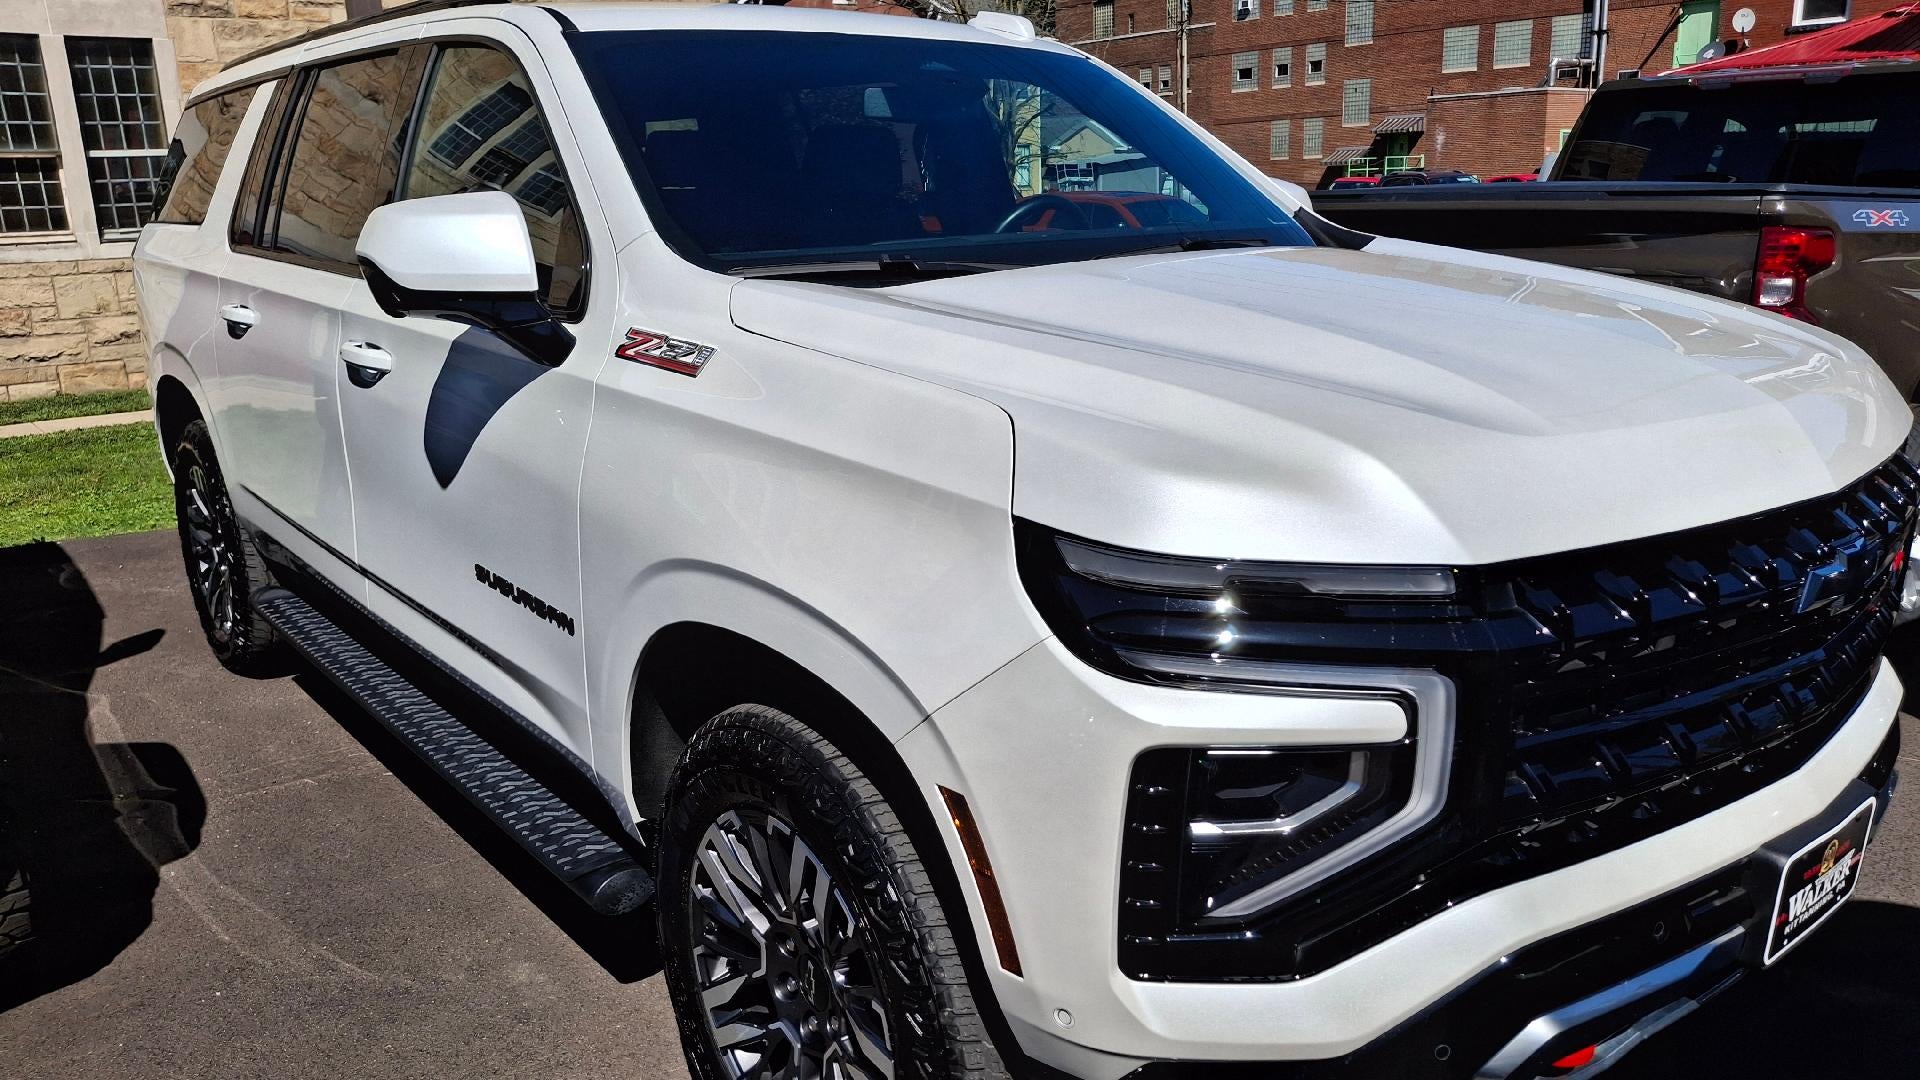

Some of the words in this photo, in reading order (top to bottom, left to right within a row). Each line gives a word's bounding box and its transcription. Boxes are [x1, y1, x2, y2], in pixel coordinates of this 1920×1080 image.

[615, 327, 717, 378] Z71
[474, 563, 575, 637] SUBURBAN
[1788, 847, 1856, 922] WALKER
